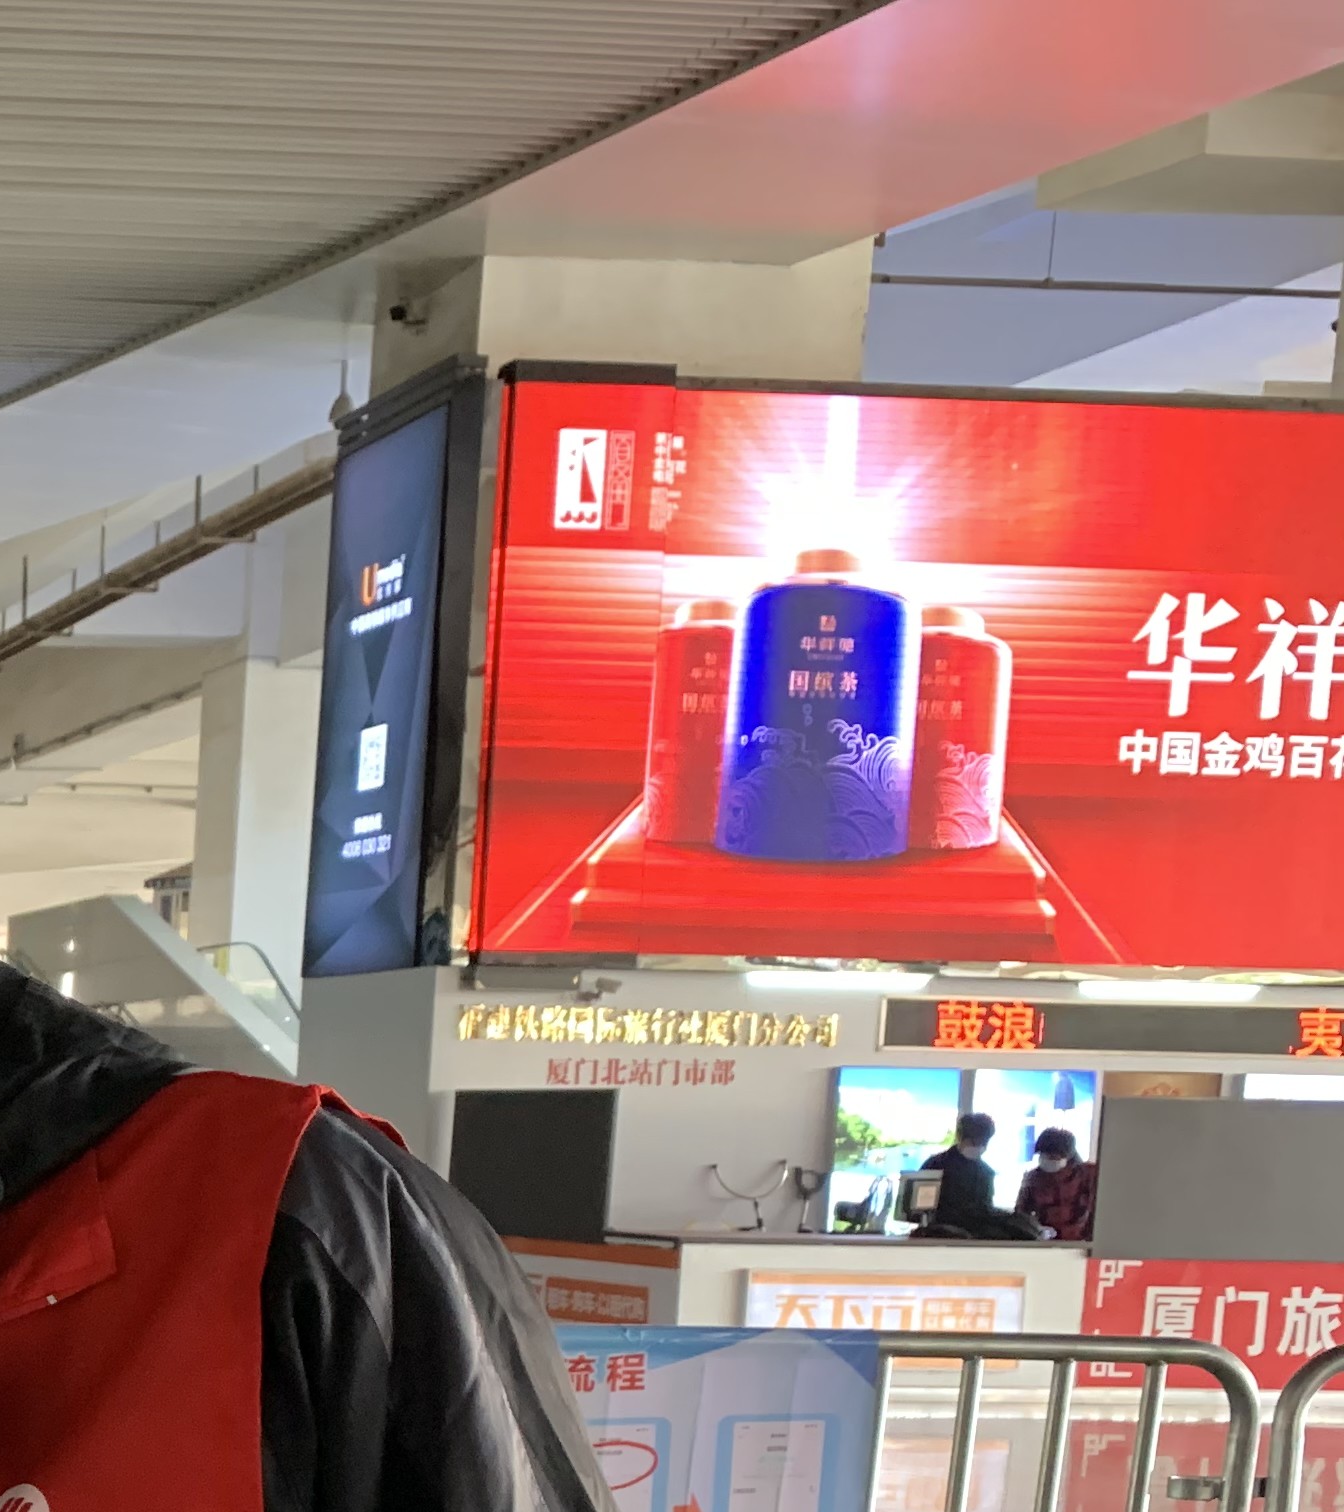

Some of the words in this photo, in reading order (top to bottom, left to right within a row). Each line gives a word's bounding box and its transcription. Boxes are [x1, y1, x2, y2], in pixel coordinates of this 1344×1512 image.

[1127, 592, 1344, 721] 华祥
[933, 1001, 1045, 1049] 鼓浪
[545, 1057, 737, 1086] 厦门北站门市部
[1140, 1286, 1344, 1357] 厦门旅
